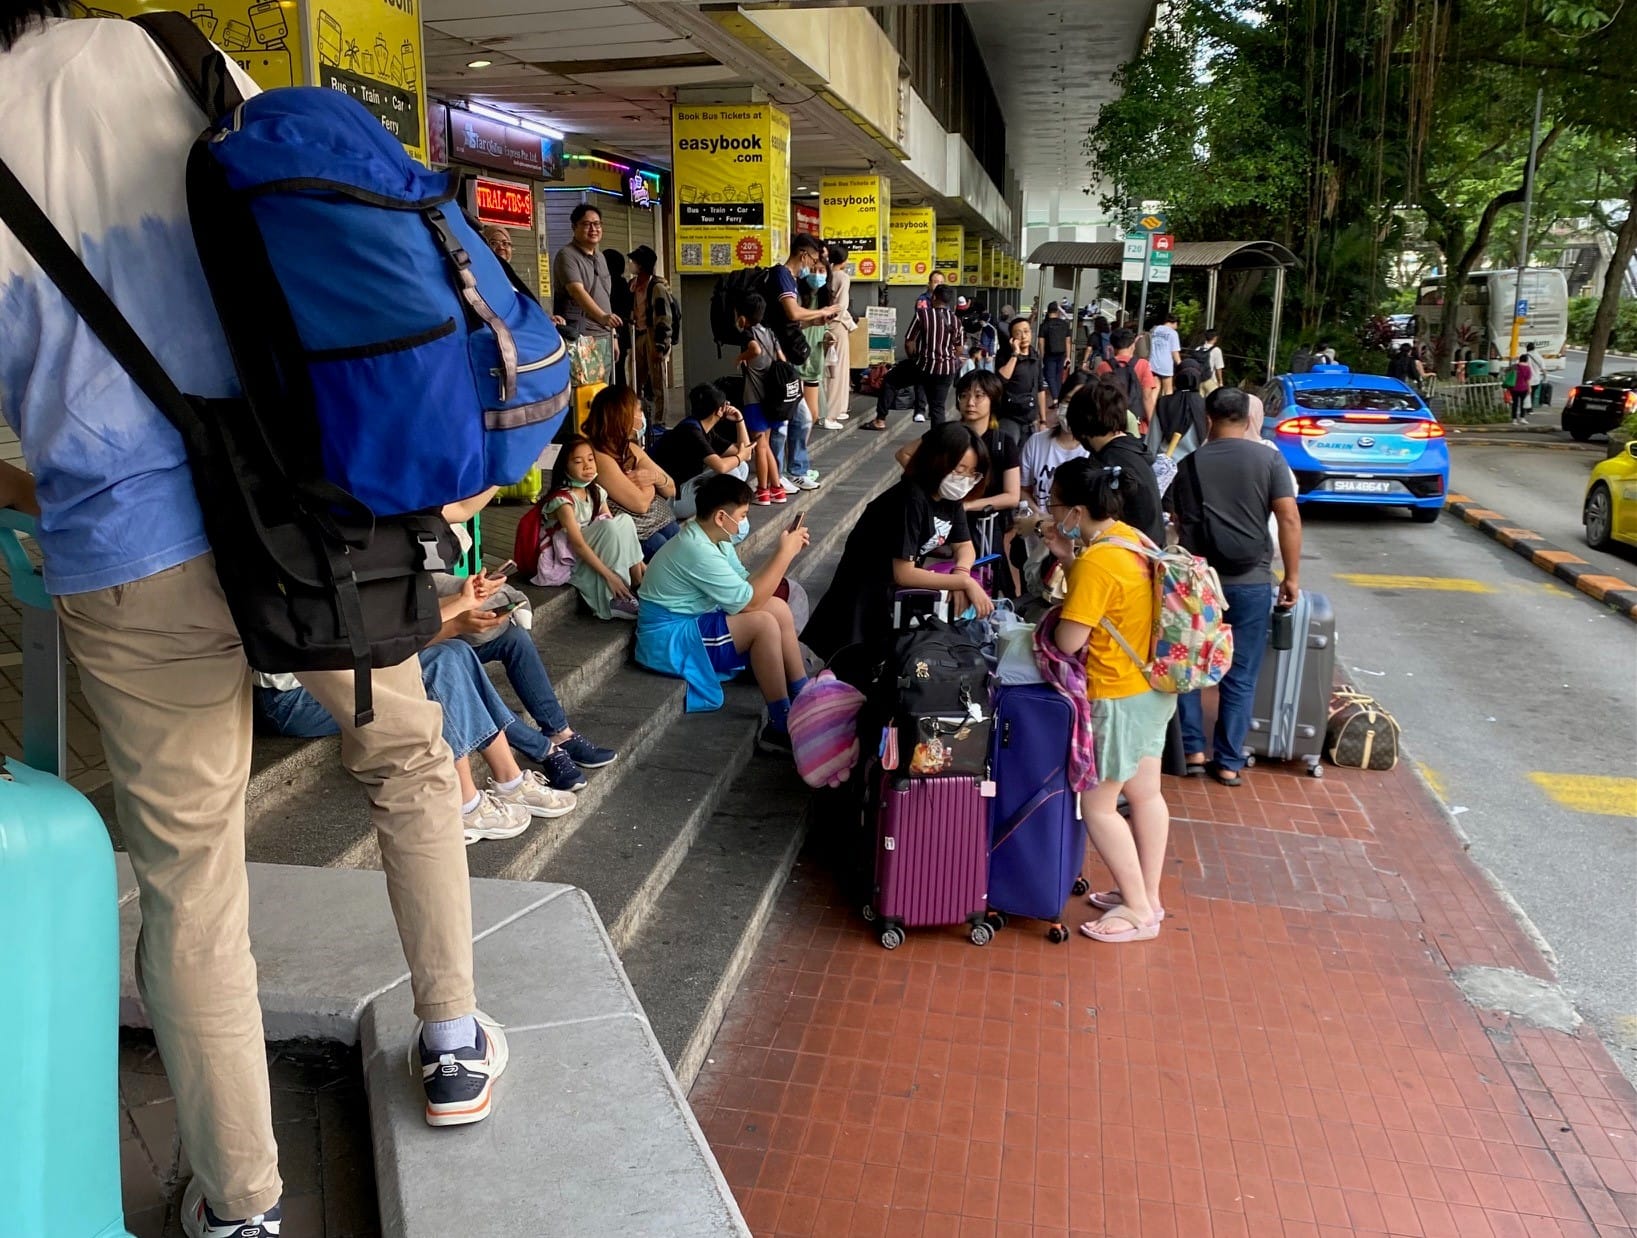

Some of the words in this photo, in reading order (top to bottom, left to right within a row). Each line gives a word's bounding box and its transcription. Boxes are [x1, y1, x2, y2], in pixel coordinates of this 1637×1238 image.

[361, 86, 380, 105] Train
[392, 96, 404, 112] Car
[678, 112, 700, 120] Book
[702, 112, 718, 120] Bus
[721, 111, 751, 120] Tickets
[753, 111, 762, 119] at
[381, 115, 399, 135] Ferry
[679, 134, 762, 153] easybook
[733, 153, 763, 163] .com
[823, 194, 876, 207] easybook
[687, 206, 700, 214] Bus
[710, 206, 726, 214] Train
[736, 206, 749, 214] Car
[701, 215, 715, 223] Tour
[725, 215, 743, 223] Ferry
[890, 221, 928, 229] easybook
